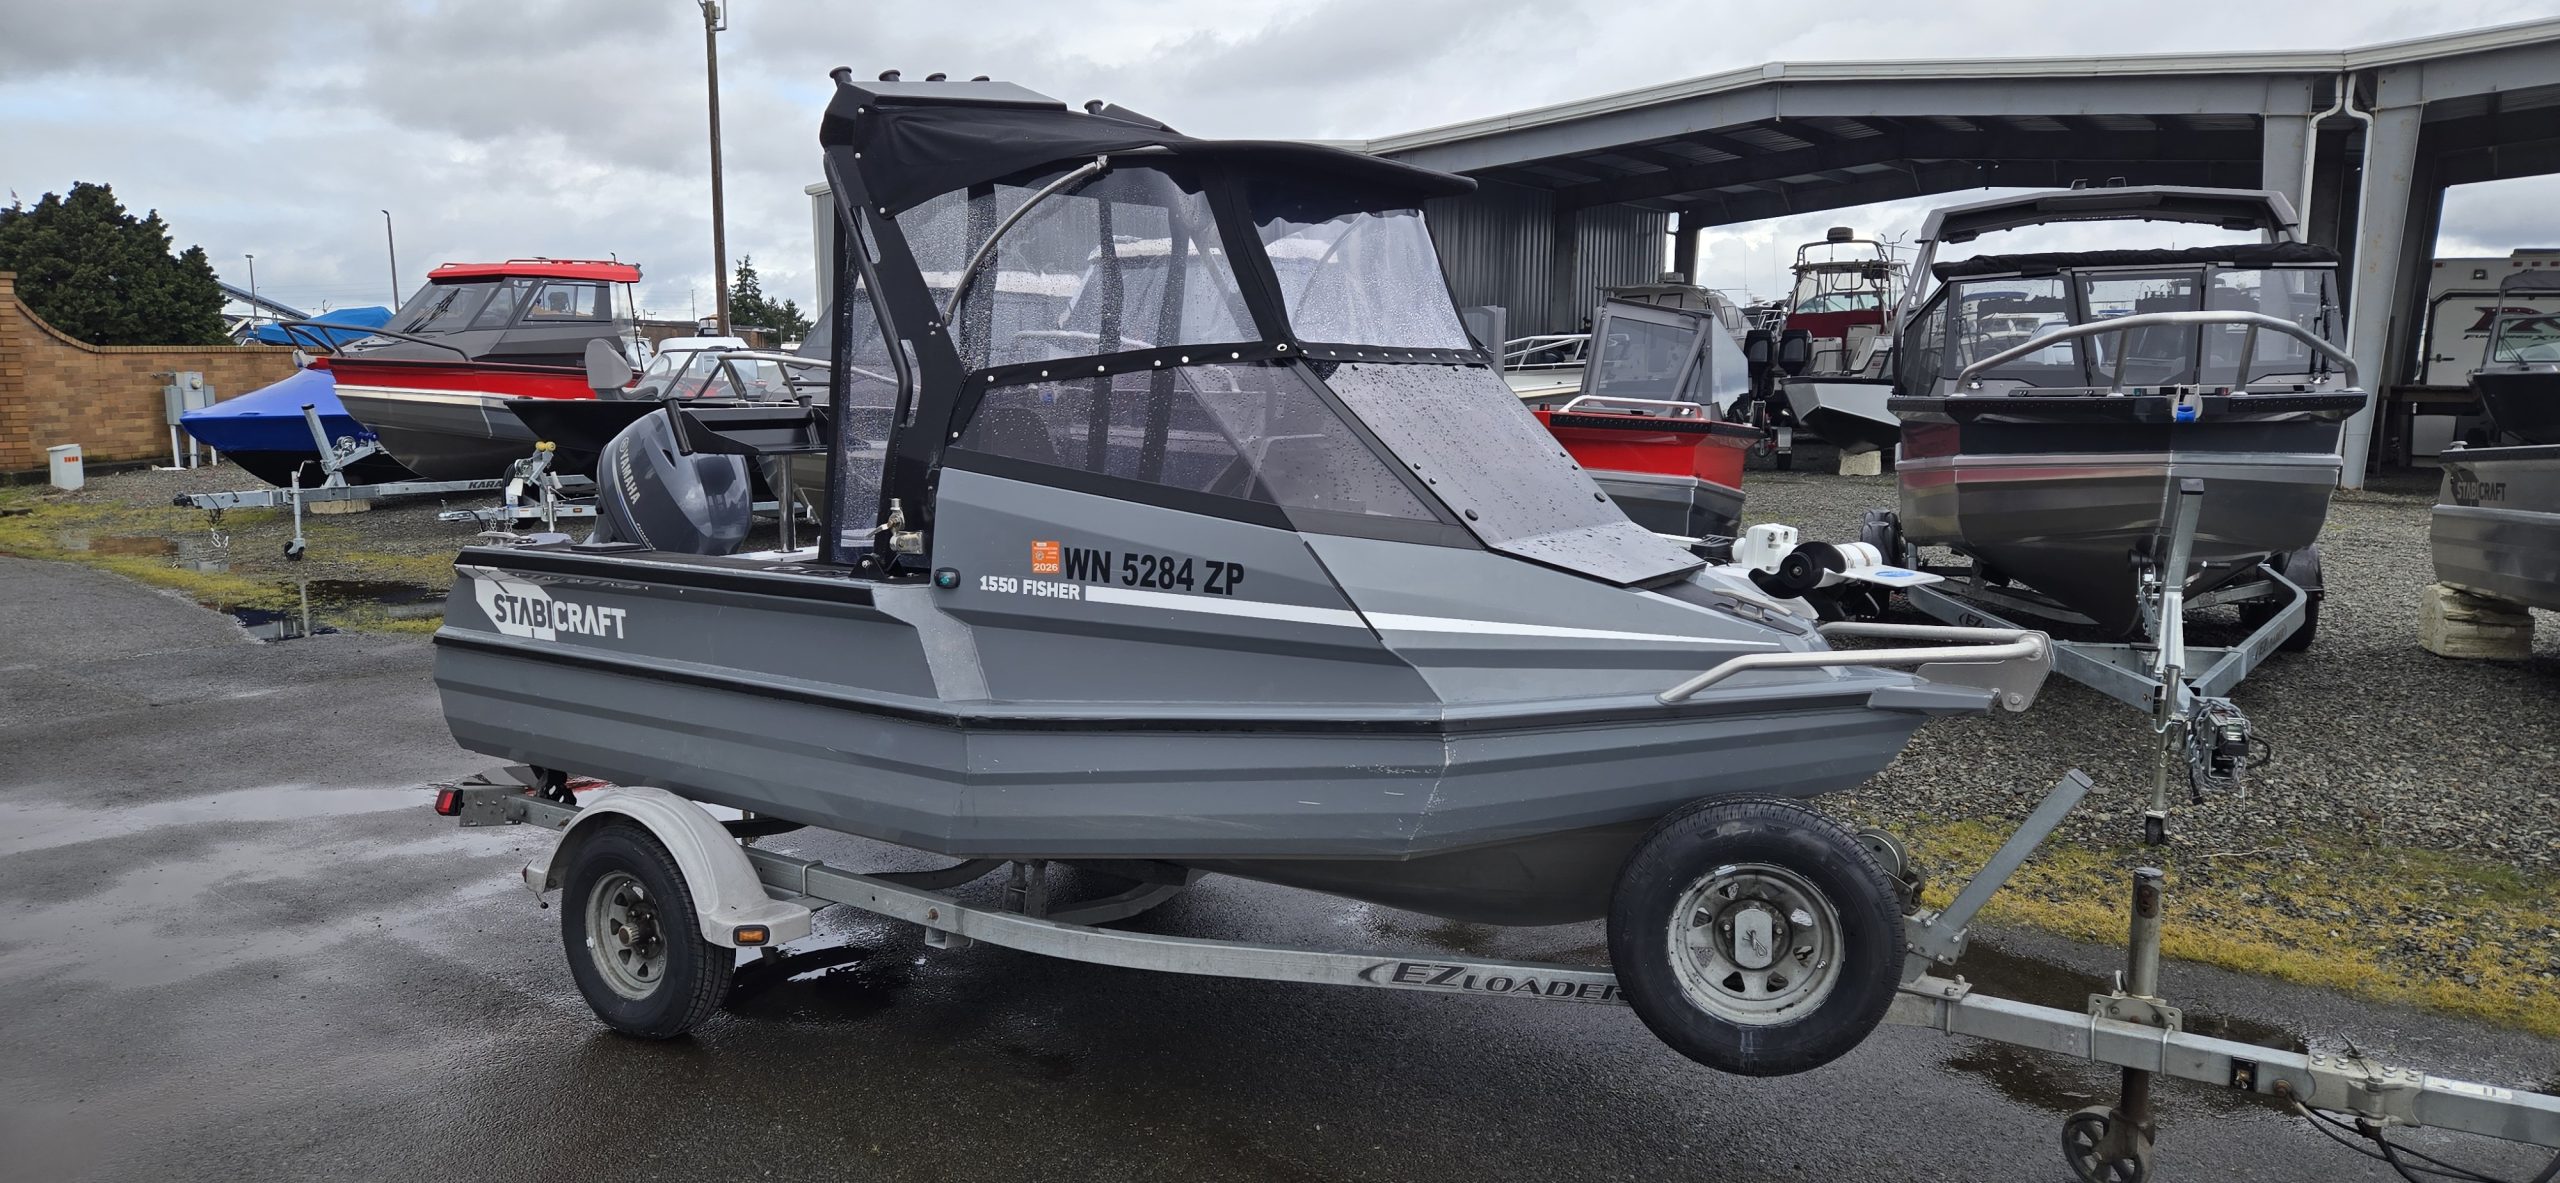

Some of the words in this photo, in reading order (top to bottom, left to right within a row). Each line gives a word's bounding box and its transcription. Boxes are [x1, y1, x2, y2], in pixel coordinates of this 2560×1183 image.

[619, 449, 641, 505] YAMAHA
[2457, 481, 2506, 501] STABICRAFT
[1033, 563, 1058, 571] 2026
[1064, 547, 1111, 583] WN
[1122, 552, 1194, 592] 5284
[1204, 560, 1245, 595] ZP
[979, 575, 1017, 593] 1550
[1023, 579, 1080, 600] FISHER
[493, 593, 627, 640] STABICRAFT
